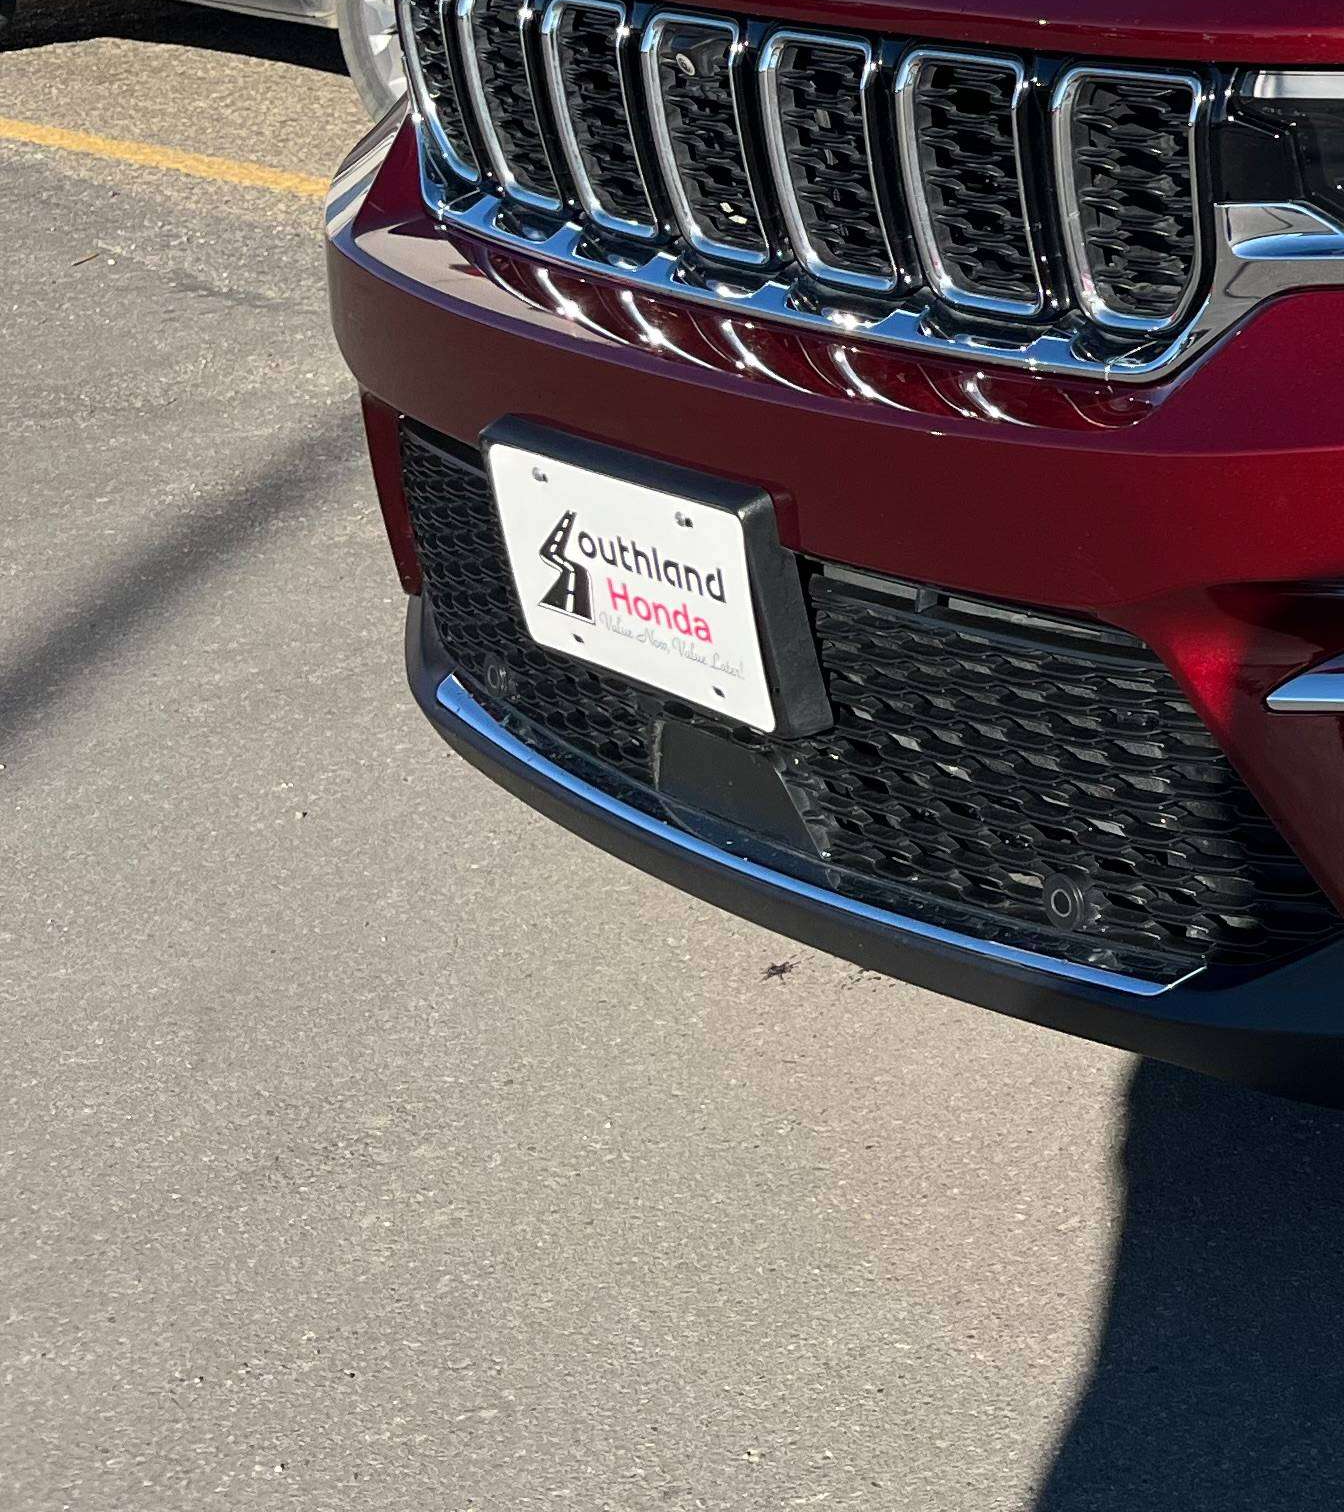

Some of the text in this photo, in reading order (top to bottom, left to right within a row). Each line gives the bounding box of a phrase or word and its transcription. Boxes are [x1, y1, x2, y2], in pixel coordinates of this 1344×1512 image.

[599, 610, 634, 639] Value
[672, 635, 707, 666] Value
[606, 577, 713, 644] Honda
